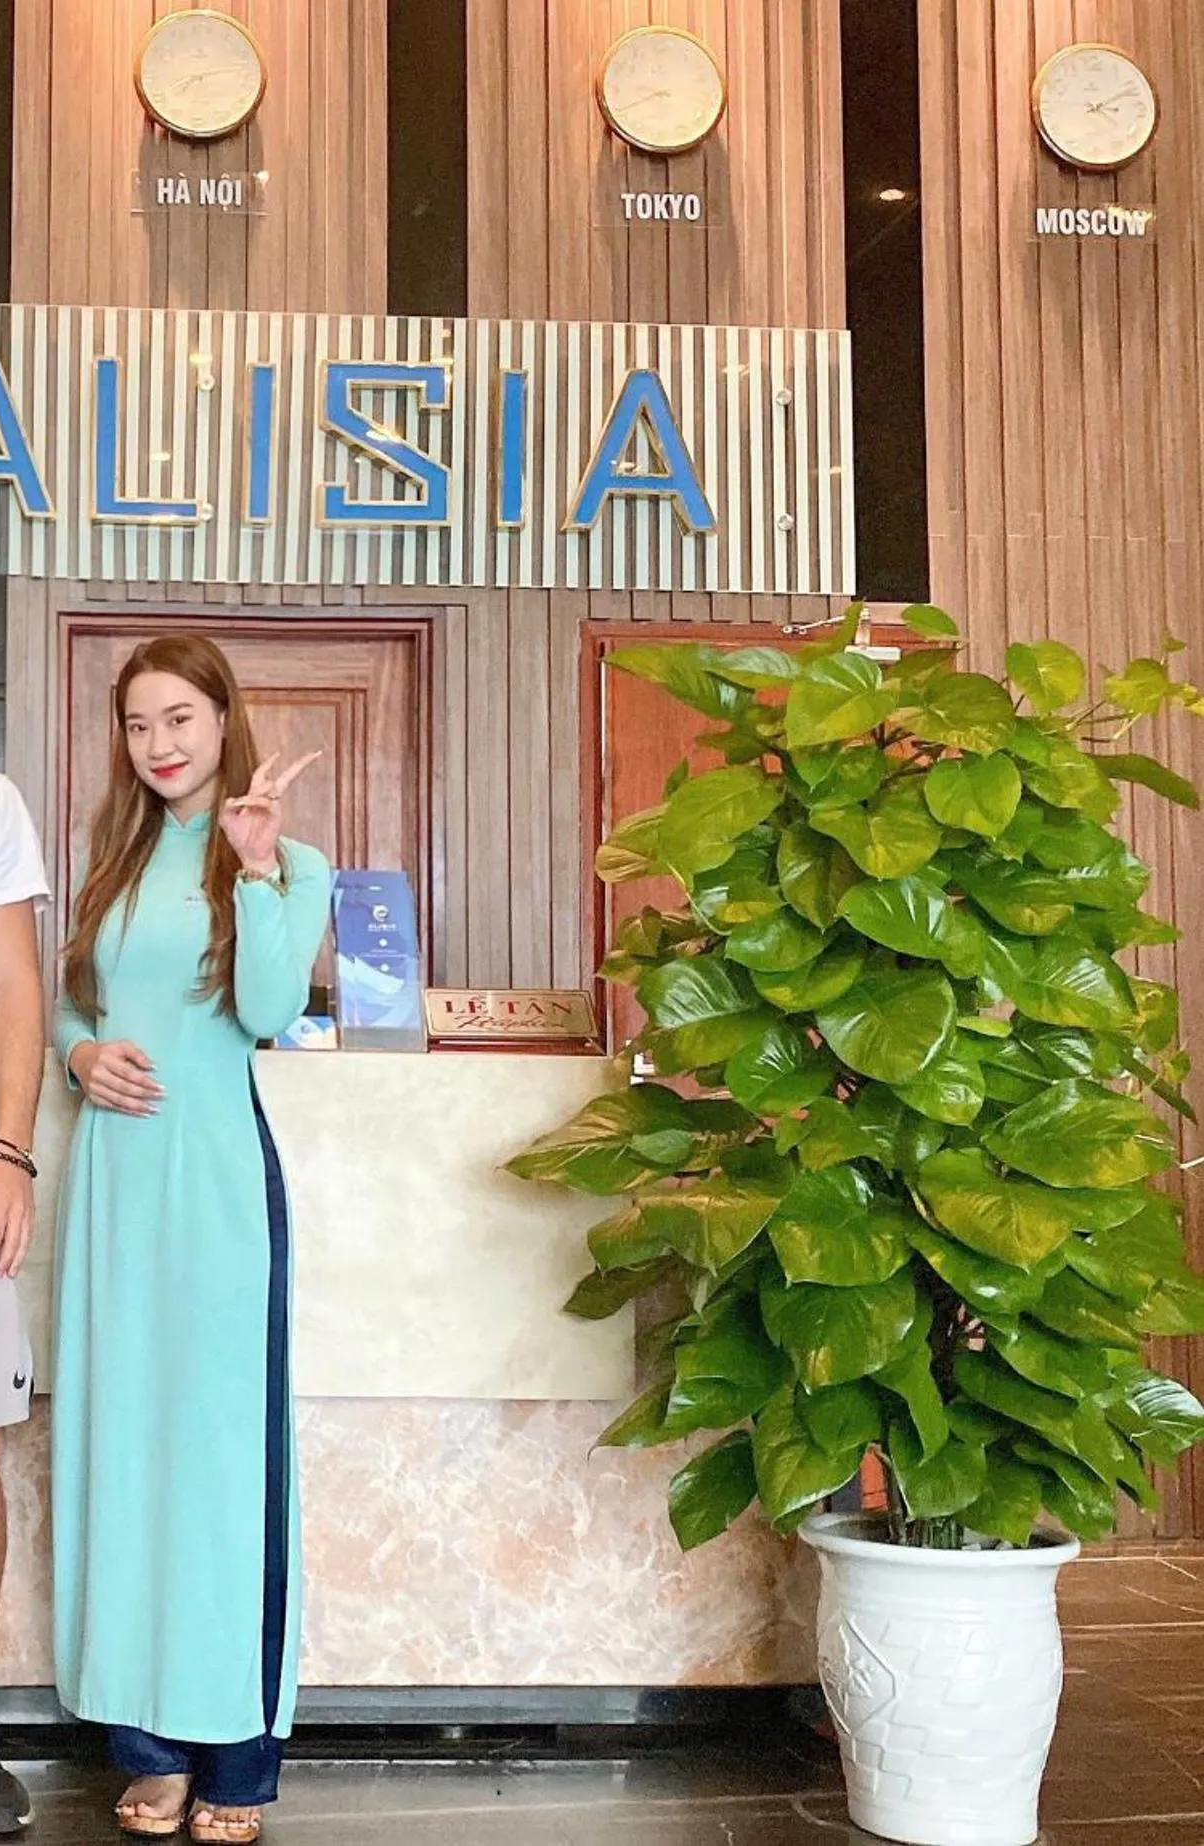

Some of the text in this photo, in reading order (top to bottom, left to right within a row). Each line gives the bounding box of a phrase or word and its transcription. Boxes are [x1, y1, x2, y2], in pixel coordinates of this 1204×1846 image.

[157, 171, 242, 212] HÀ NỘI
[620, 193, 701, 220] TOKYO
[1036, 207, 1152, 236] MOSCOW
[499, 997, 573, 1015] TÂN
